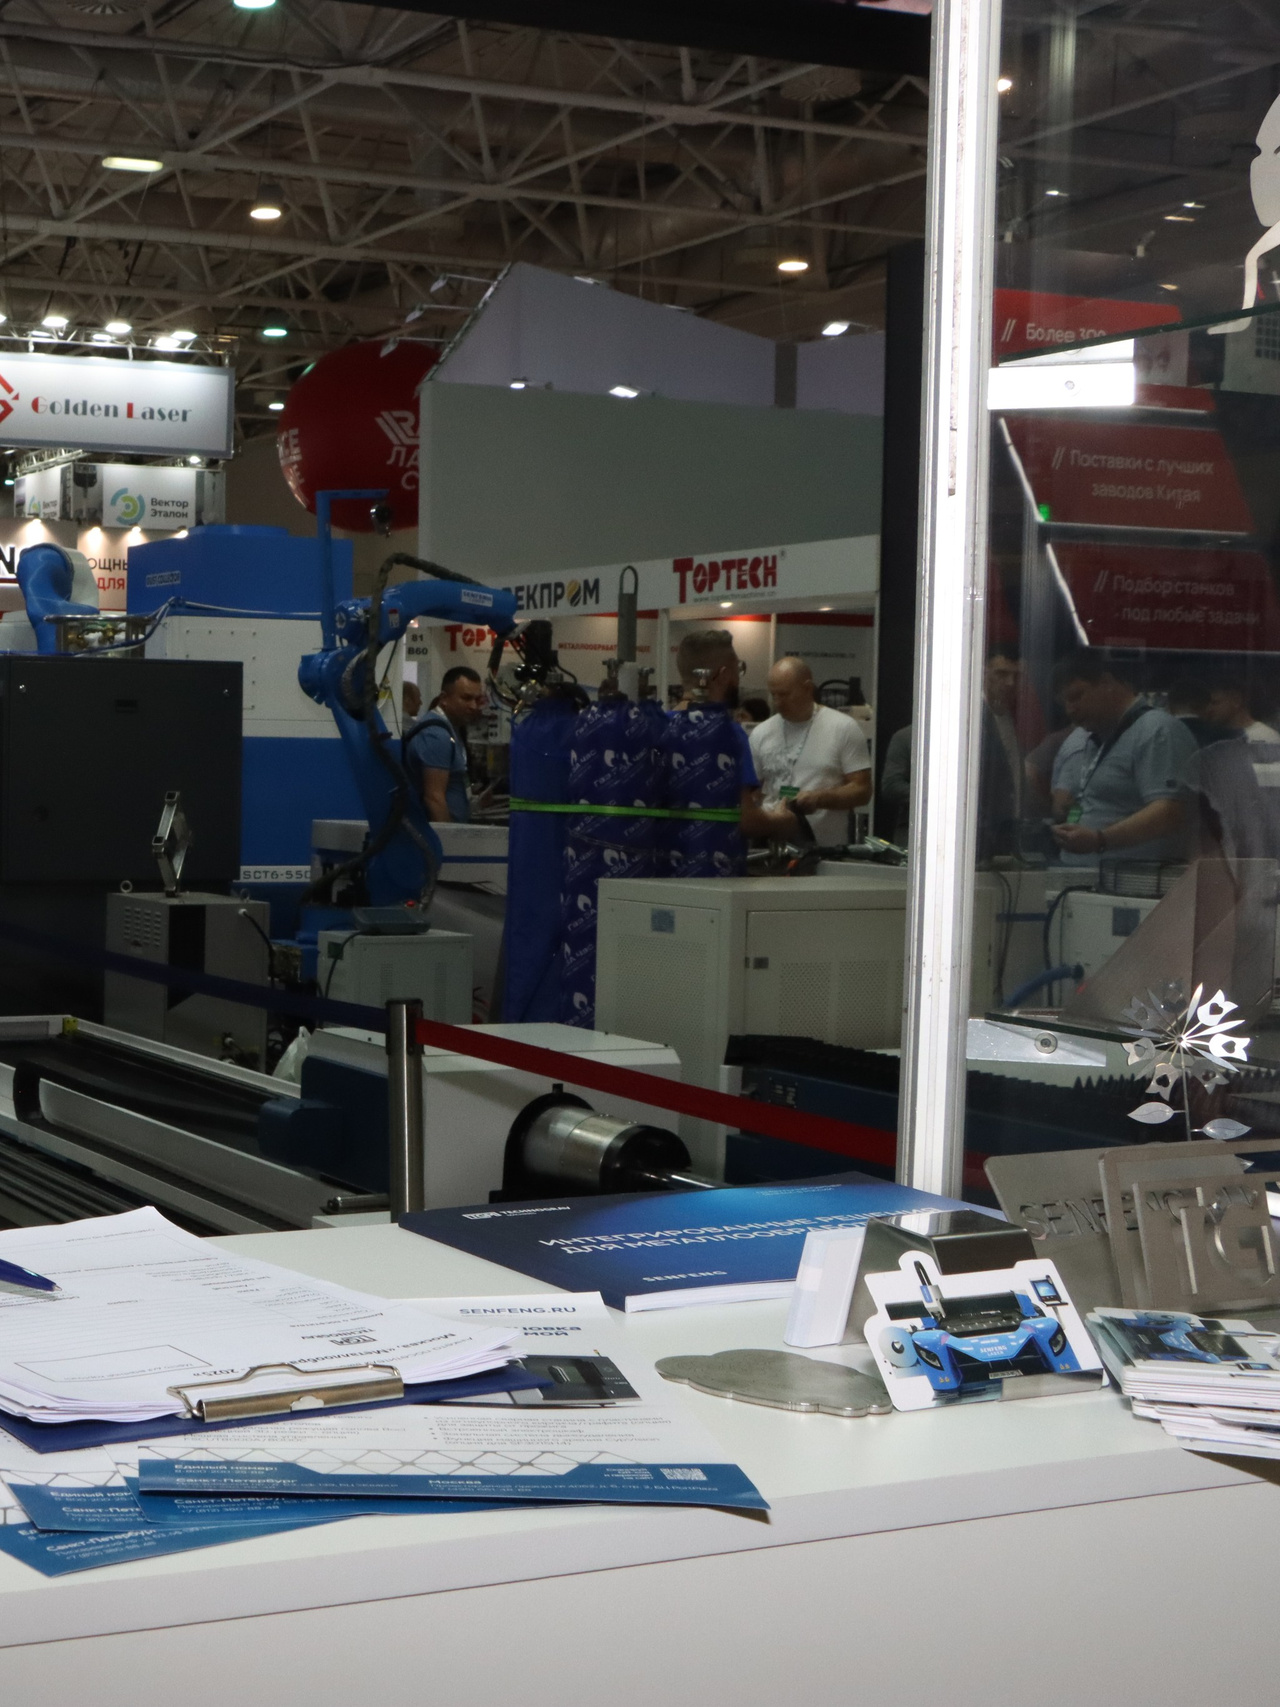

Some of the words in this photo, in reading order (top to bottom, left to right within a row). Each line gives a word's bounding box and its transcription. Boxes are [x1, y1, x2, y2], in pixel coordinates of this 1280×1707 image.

[1026, 323, 1074, 342] Более
[31, 396, 118, 418] Golden
[126, 402, 192, 422] Laser
[1070, 450, 1142, 469] Поставки
[1144, 459, 1154, 471] с
[1158, 461, 1214, 476] лучших
[1092, 484, 1153, 498] заводов
[1156, 484, 1201, 502] Китая
[150, 498, 188, 509] Вектор
[150, 510, 188, 518] Эталон
[97, 578, 125, 590] ДЛЯ
[673, 555, 777, 604] TOPTECH
[539, 1218, 817, 1246] ИНТЕГРИРОВАННЫЕ
[562, 1242, 626, 1254] ДЛЯ
[642, 1270, 728, 1282] SENFENG
[460, 1306, 576, 1314] SENFENG.RU
